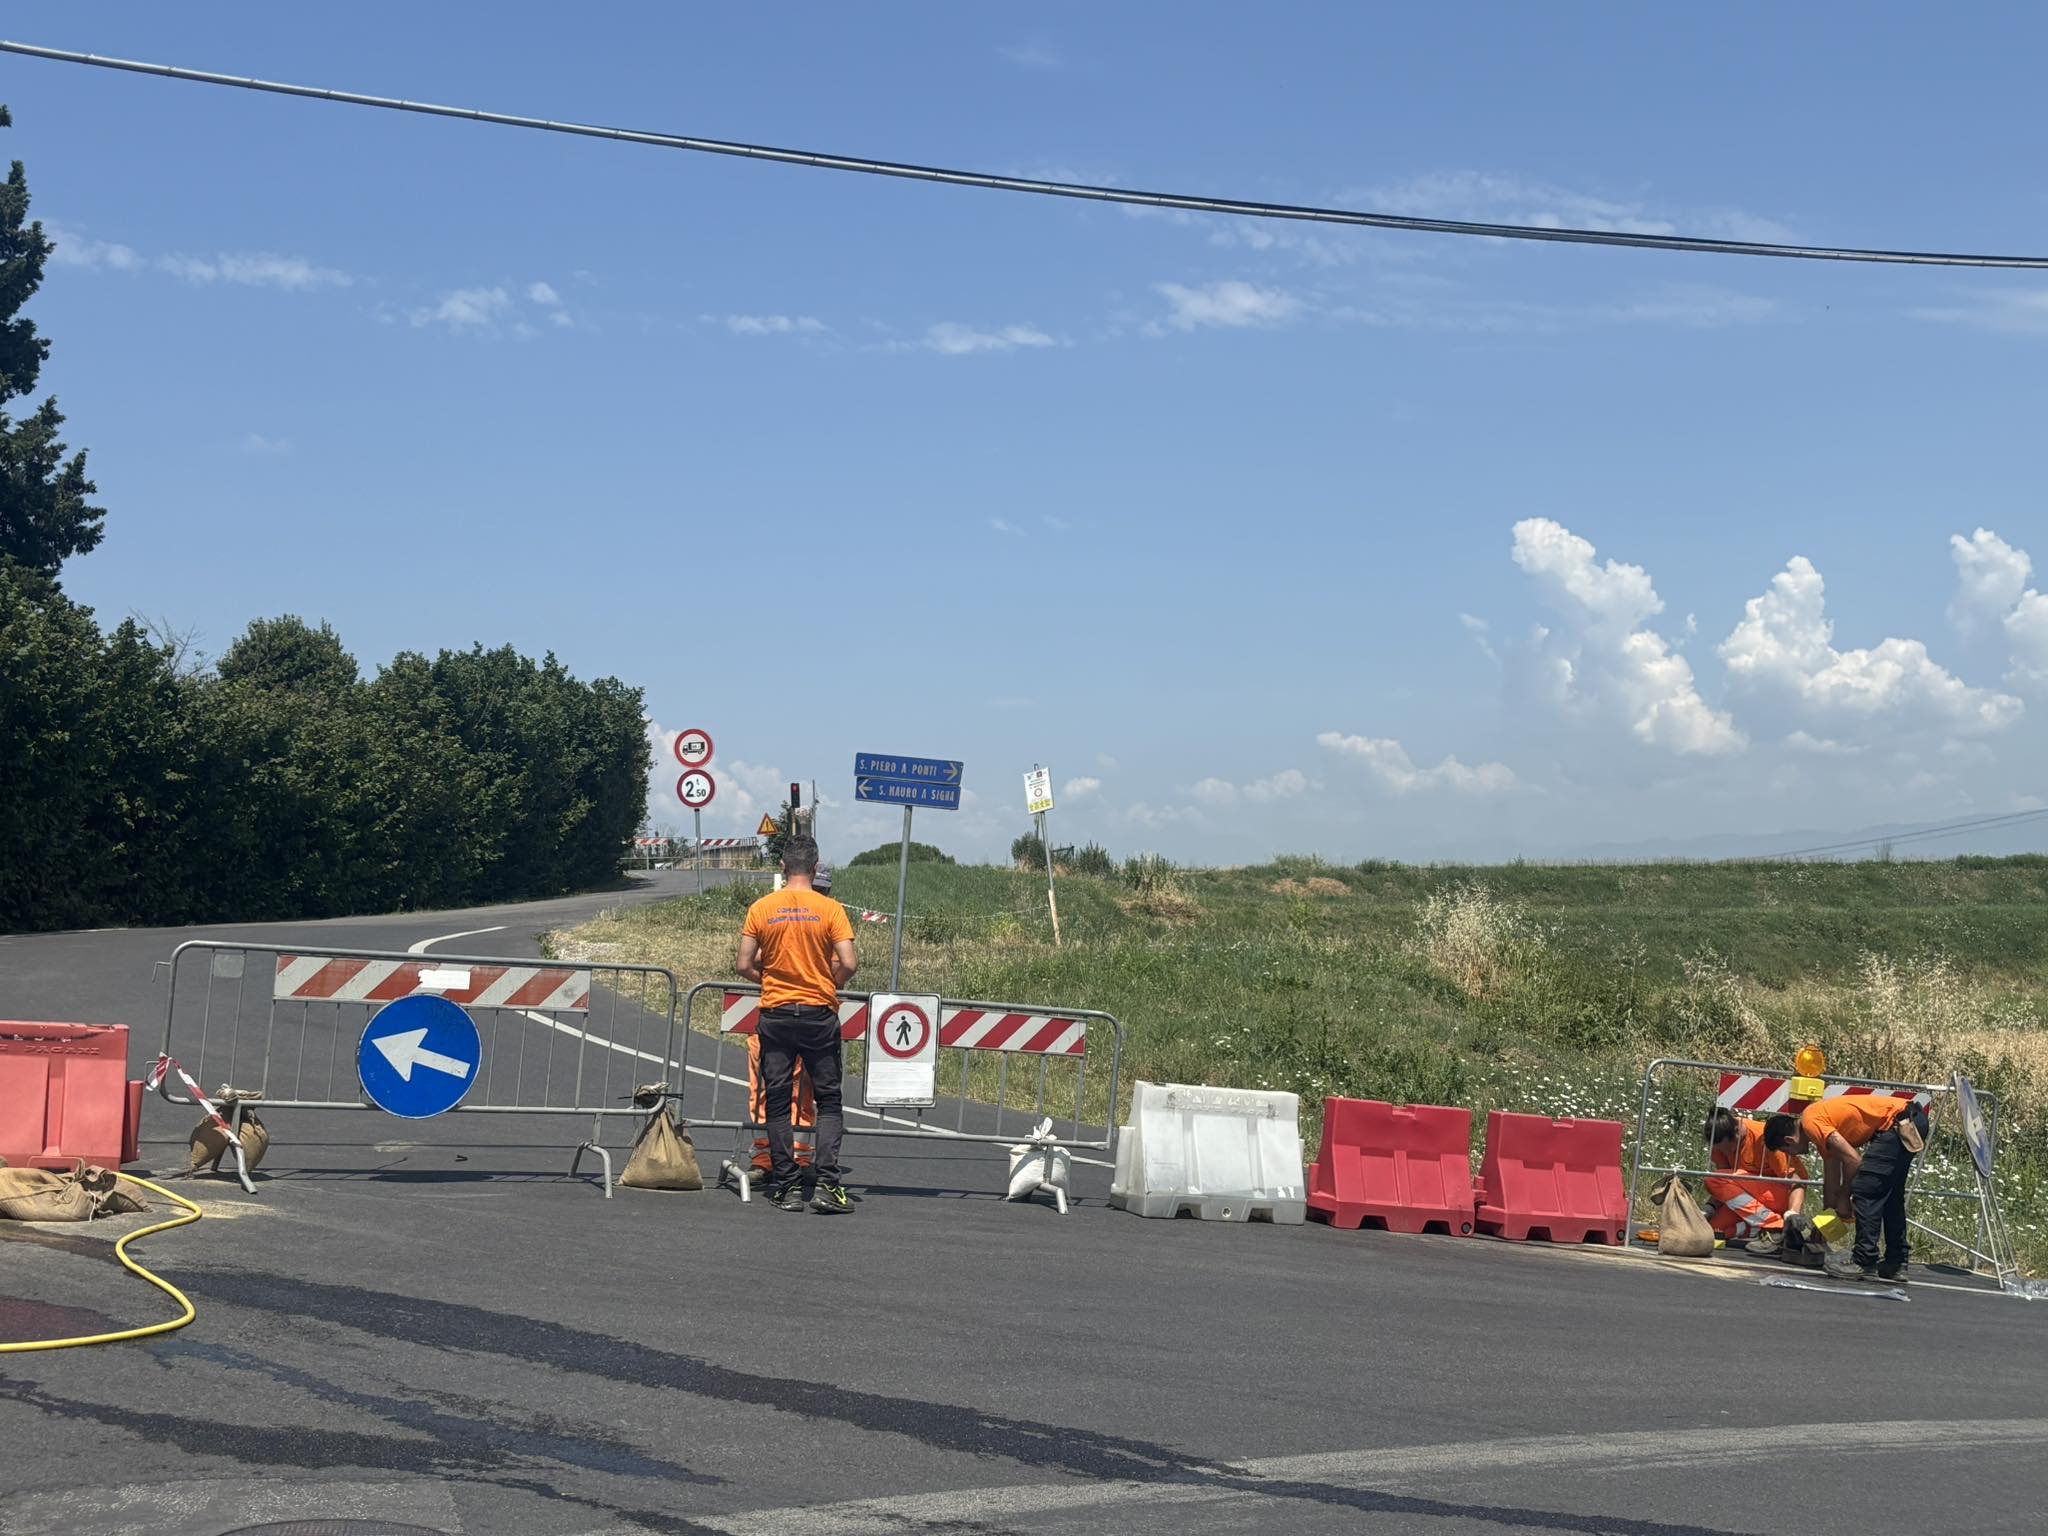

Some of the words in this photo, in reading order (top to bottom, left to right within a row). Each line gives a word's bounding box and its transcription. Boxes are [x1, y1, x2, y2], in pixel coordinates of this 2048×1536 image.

[870, 761, 896, 773] PIERO
[901, 764, 907, 774] A
[912, 765, 937, 776] PONTI
[889, 786, 918, 799] MAURO
[921, 790, 927, 799] A
[931, 790, 955, 802] SIGNA
